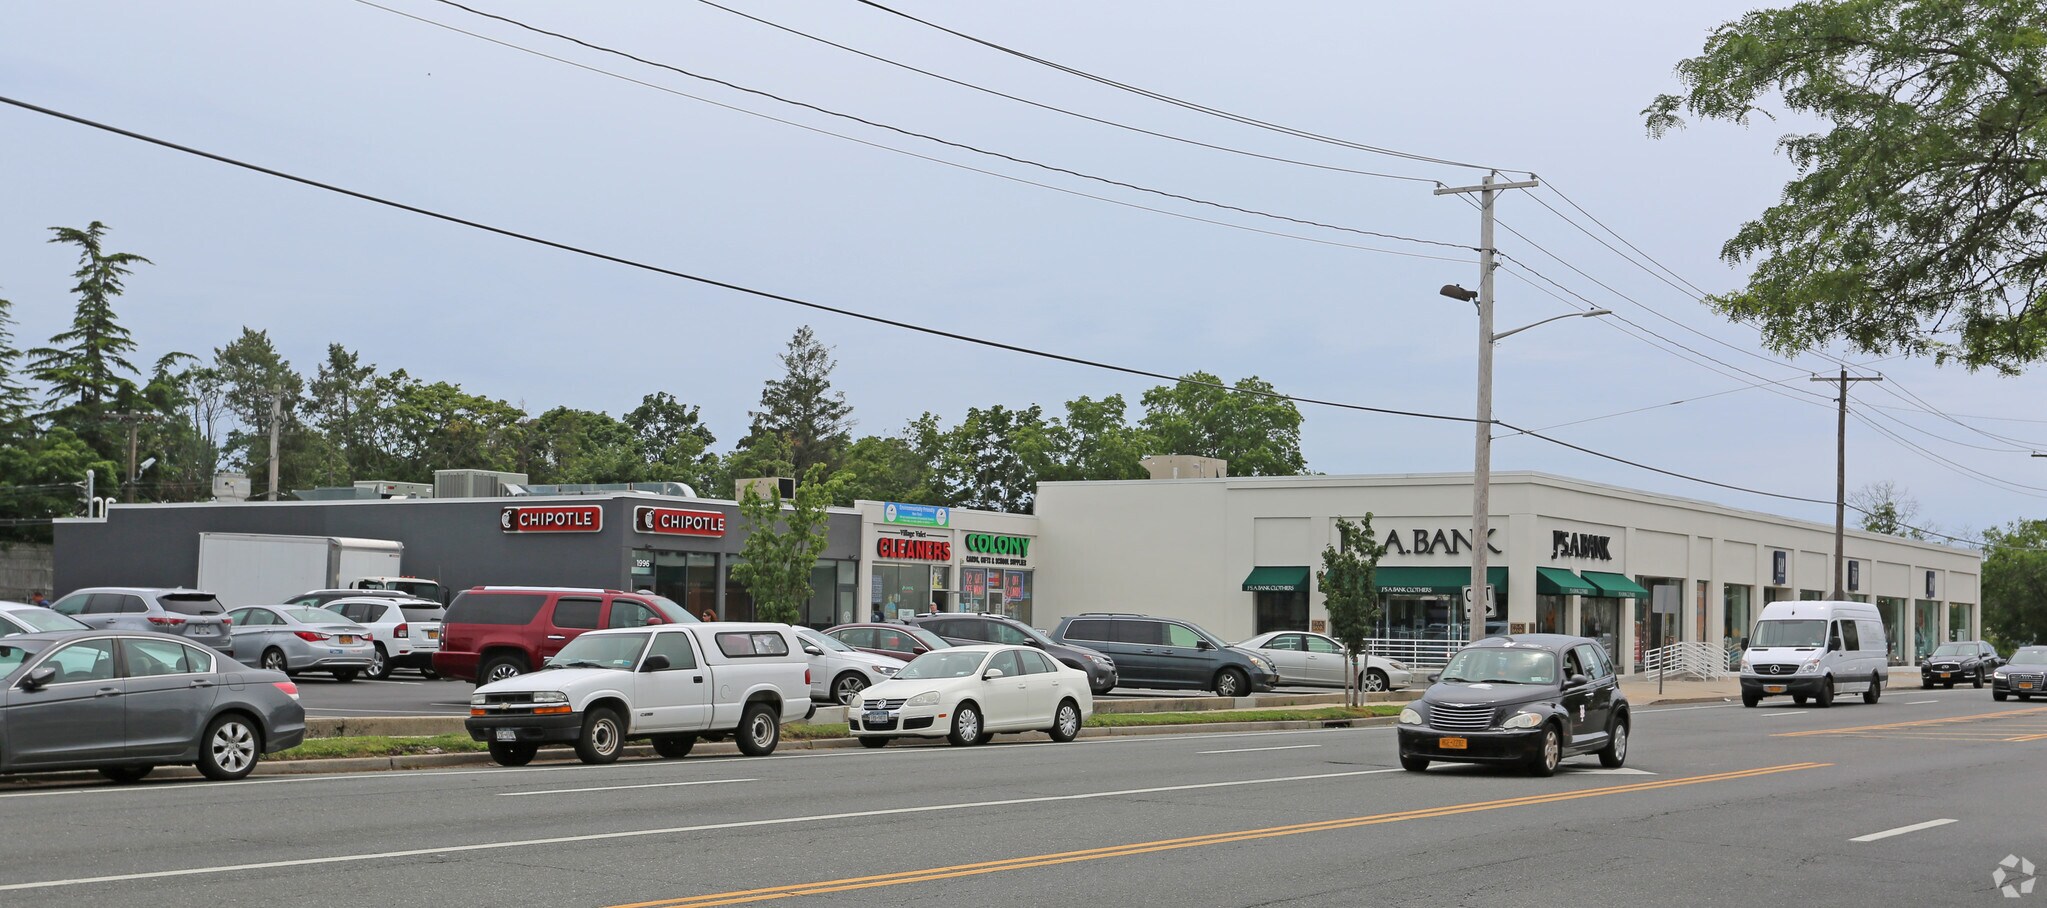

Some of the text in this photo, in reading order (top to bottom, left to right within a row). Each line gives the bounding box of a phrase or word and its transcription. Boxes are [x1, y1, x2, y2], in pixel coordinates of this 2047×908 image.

[519, 511, 593, 527] CHIPOTLE
[660, 514, 725, 532] CHIPOTLE
[900, 529, 915, 538] Village
[877, 537, 951, 561] CLEANERS
[965, 533, 1031, 558] COLONY
[636, 559, 650, 567] 1996
[1010, 558, 1027, 566] SUPPLIES
[1465, 587, 1491, 602] OT
